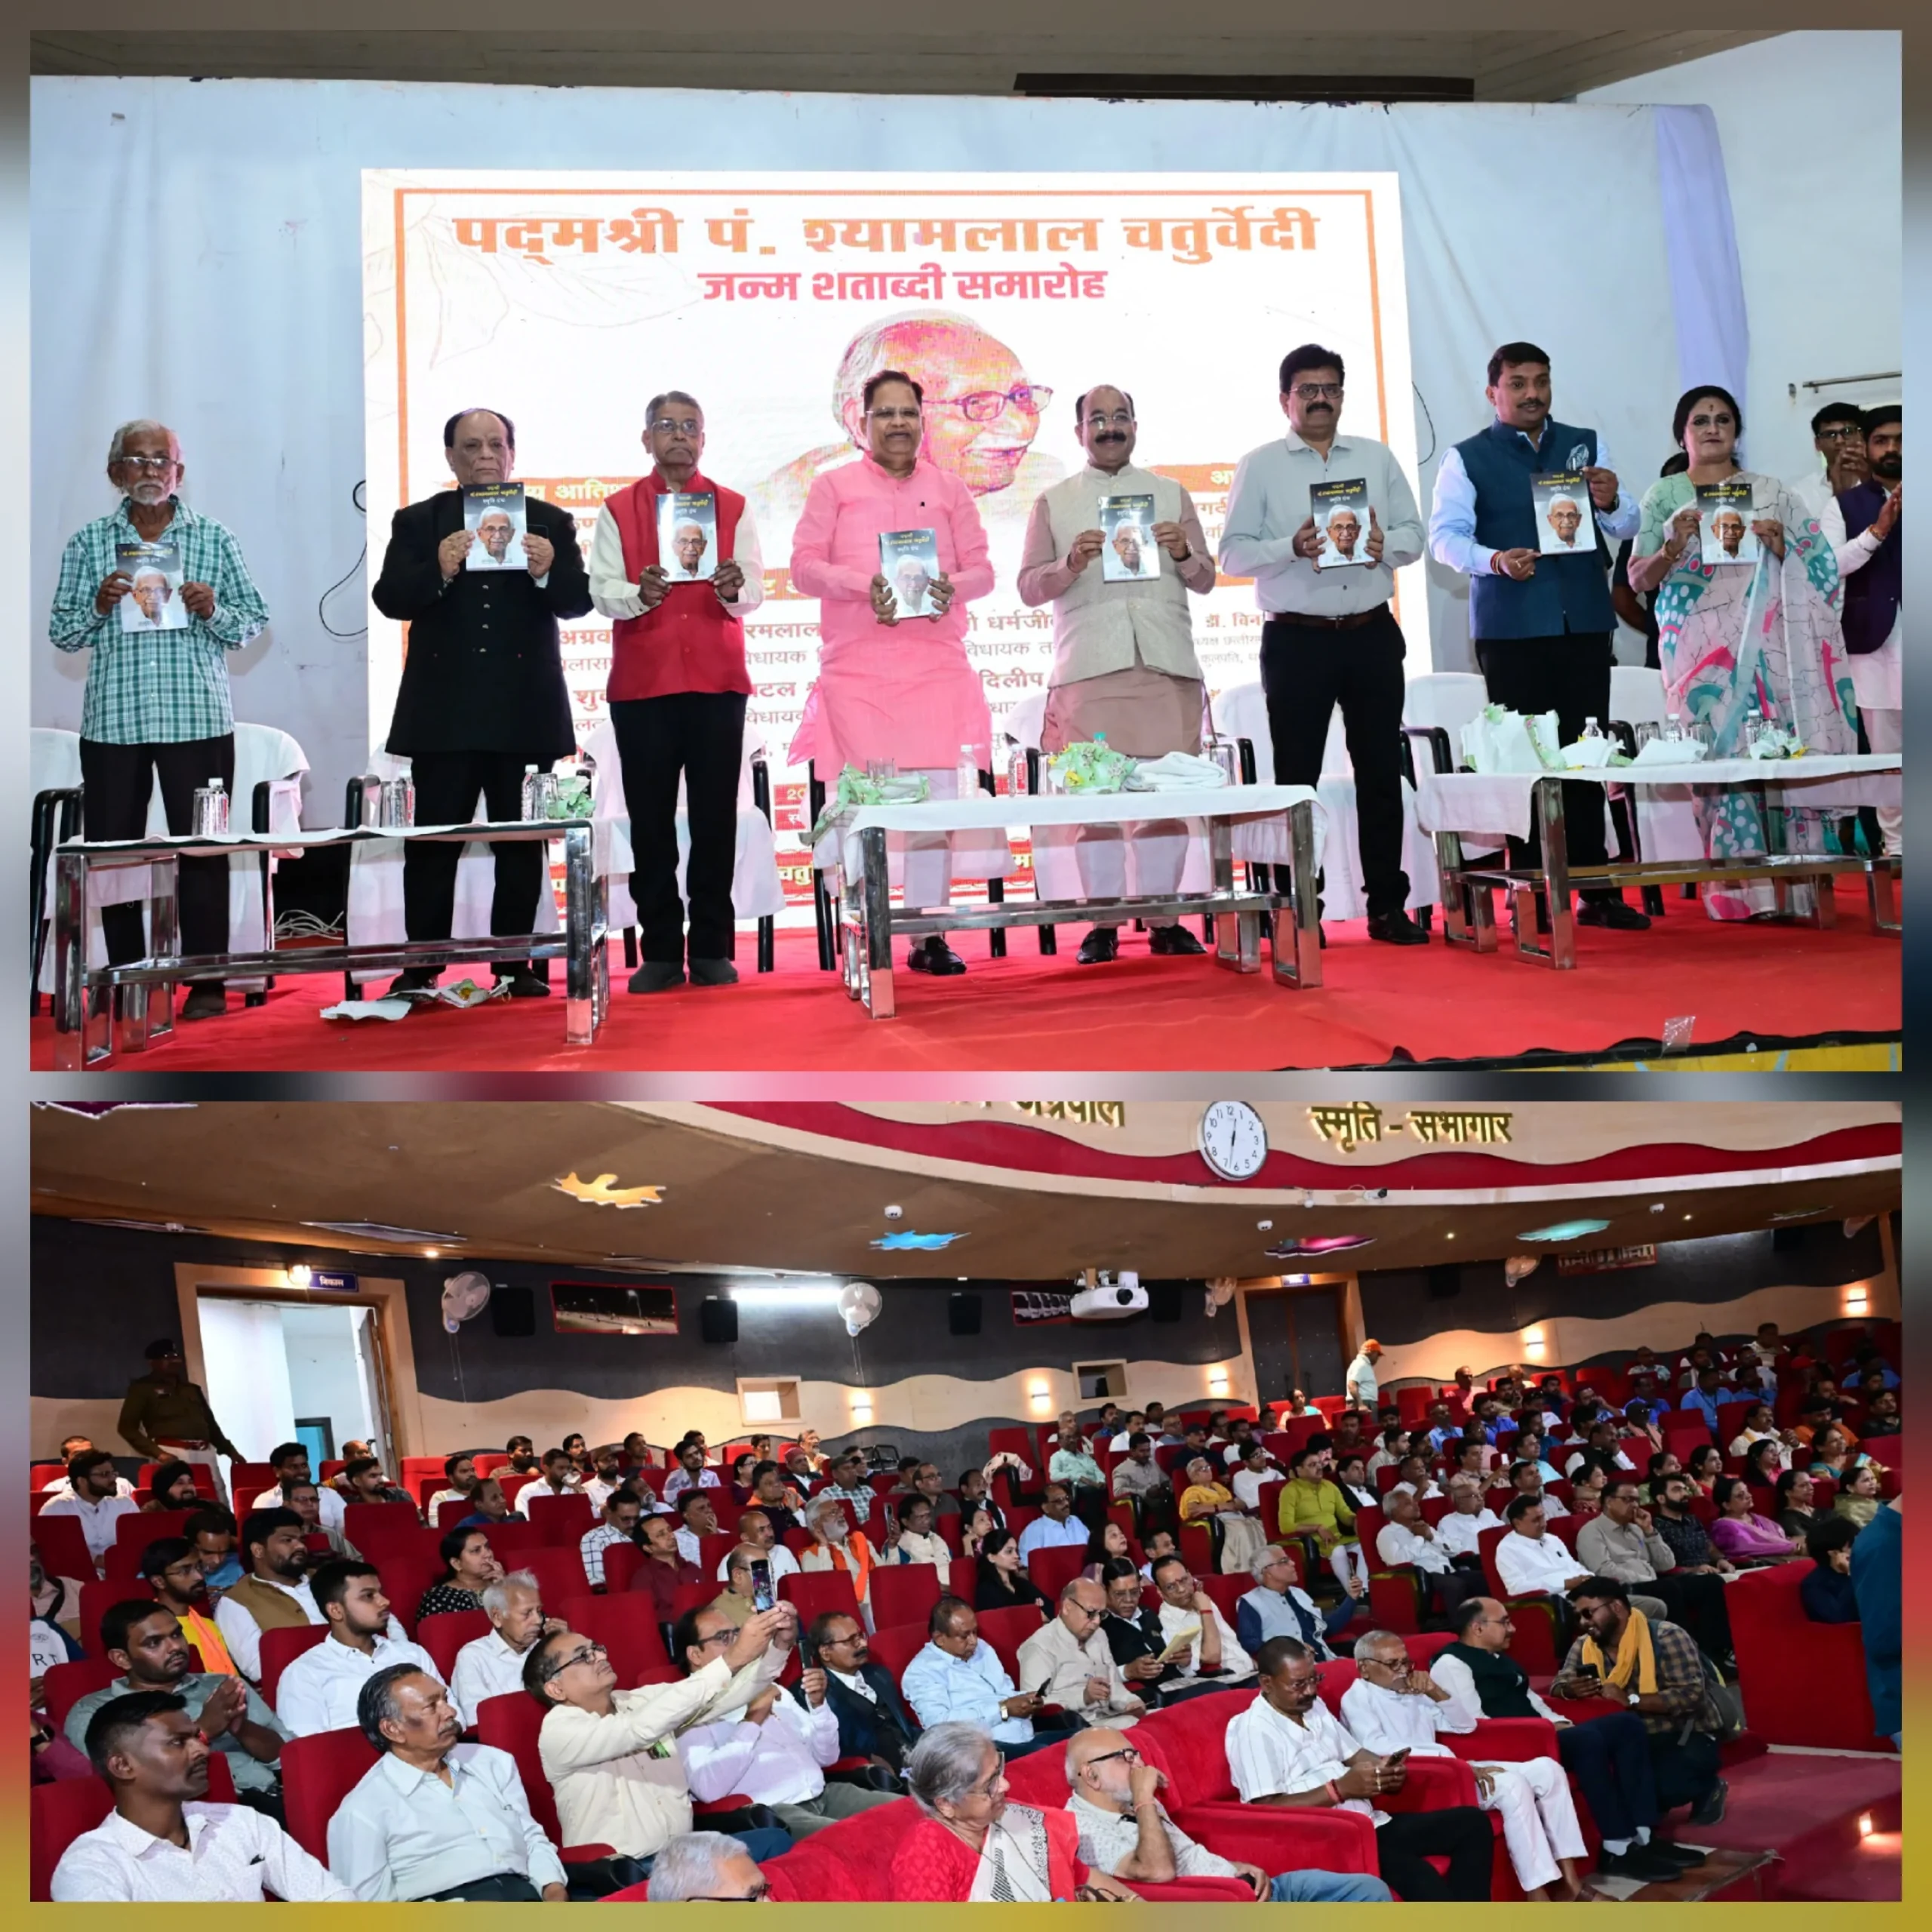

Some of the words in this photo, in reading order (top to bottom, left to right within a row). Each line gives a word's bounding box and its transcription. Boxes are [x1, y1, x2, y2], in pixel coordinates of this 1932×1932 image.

[704, 208, 776, 255] पं.
[802, 217, 1103, 255] श्यामलाल
[1121, 206, 1321, 264] चतुर्वेदी
[697, 271, 801, 301] जन्म
[812, 263, 946, 301] शताब्दी
[952, 262, 1109, 300] समारोह
[560, 629, 613, 645] अग्रव
[744, 623, 820, 638] रमलाल
[987, 609, 1054, 631] धर्मजी
[1216, 1109, 1223, 1119] 11
[1226, 1105, 1234, 1116] 12
[1239, 1109, 1244, 1120] 1
[1209, 1118, 1218, 1128] 10
[1248, 1121, 1254, 1131] 2
[1306, 1101, 1383, 1153] स्मृति
[1405, 1111, 1513, 1145] सभागार
[1206, 1131, 1212, 1142] 9
[1254, 1135, 1260, 1146] 3
[1211, 1146, 1218, 1157] 8
[1251, 1149, 1257, 1158] 4
[1223, 1158, 1229, 1168] 7
[1233, 1161, 1240, 1171] 6
[1244, 1158, 1251, 1169] 5
